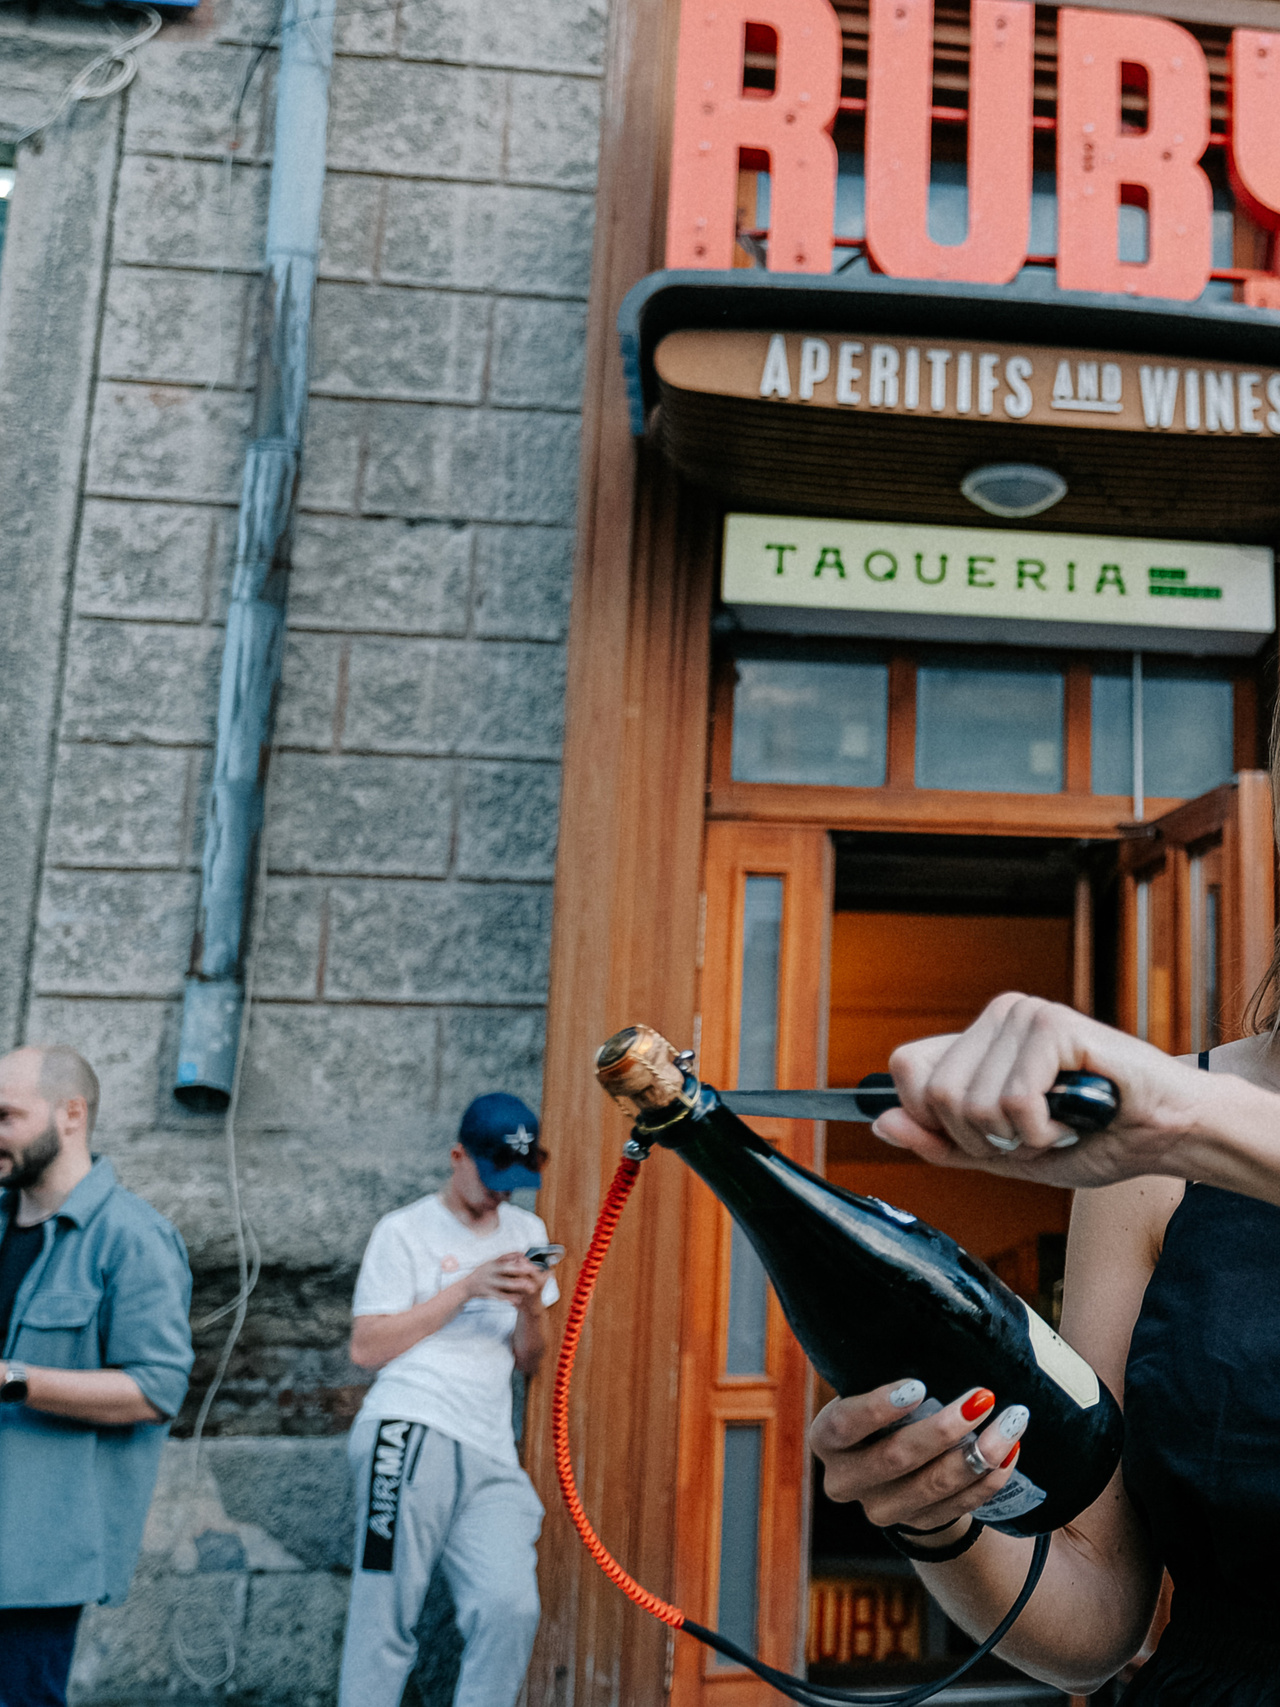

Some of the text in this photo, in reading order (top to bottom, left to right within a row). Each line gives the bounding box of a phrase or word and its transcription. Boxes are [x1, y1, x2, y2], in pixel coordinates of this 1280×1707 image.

[759, 333, 1034, 419] APERITIFS
[1052, 359, 1123, 404] AND
[764, 542, 1127, 596] TAQUERIA
